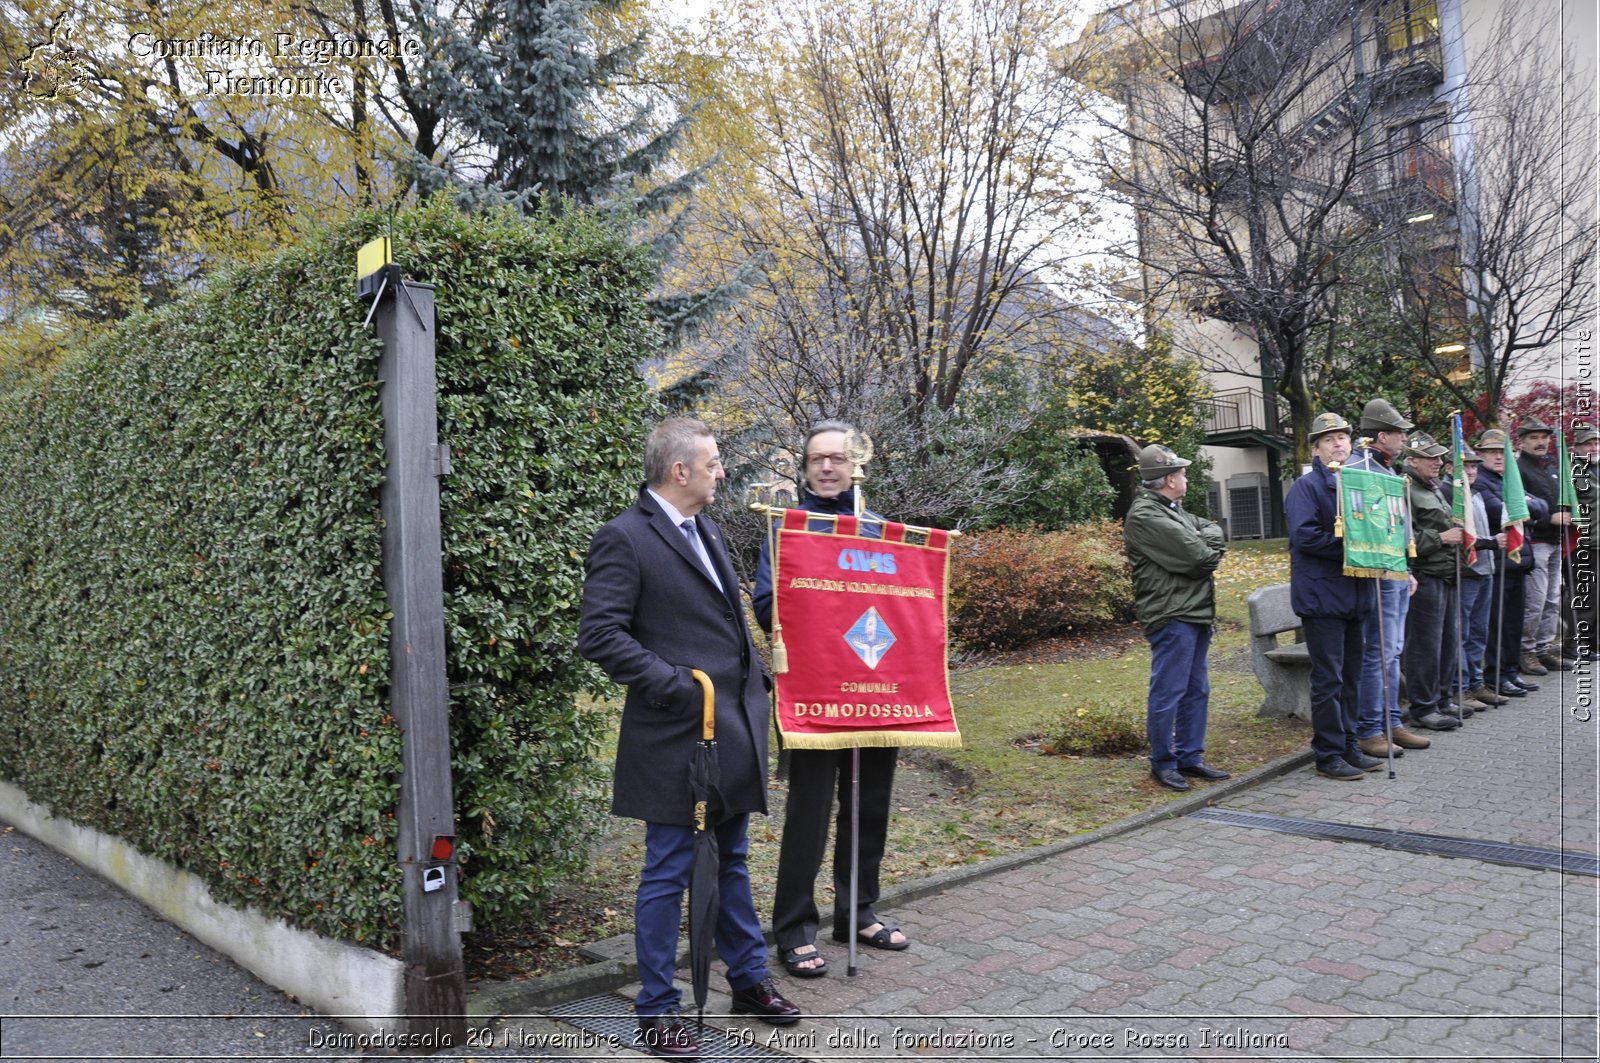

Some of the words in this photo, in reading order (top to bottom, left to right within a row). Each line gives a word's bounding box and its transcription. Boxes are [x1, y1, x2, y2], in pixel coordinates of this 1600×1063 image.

[838, 549, 897, 574] AVIS
[841, 682, 898, 694] COMUNALE
[794, 703, 935, 718] DOMODOSSOLA
